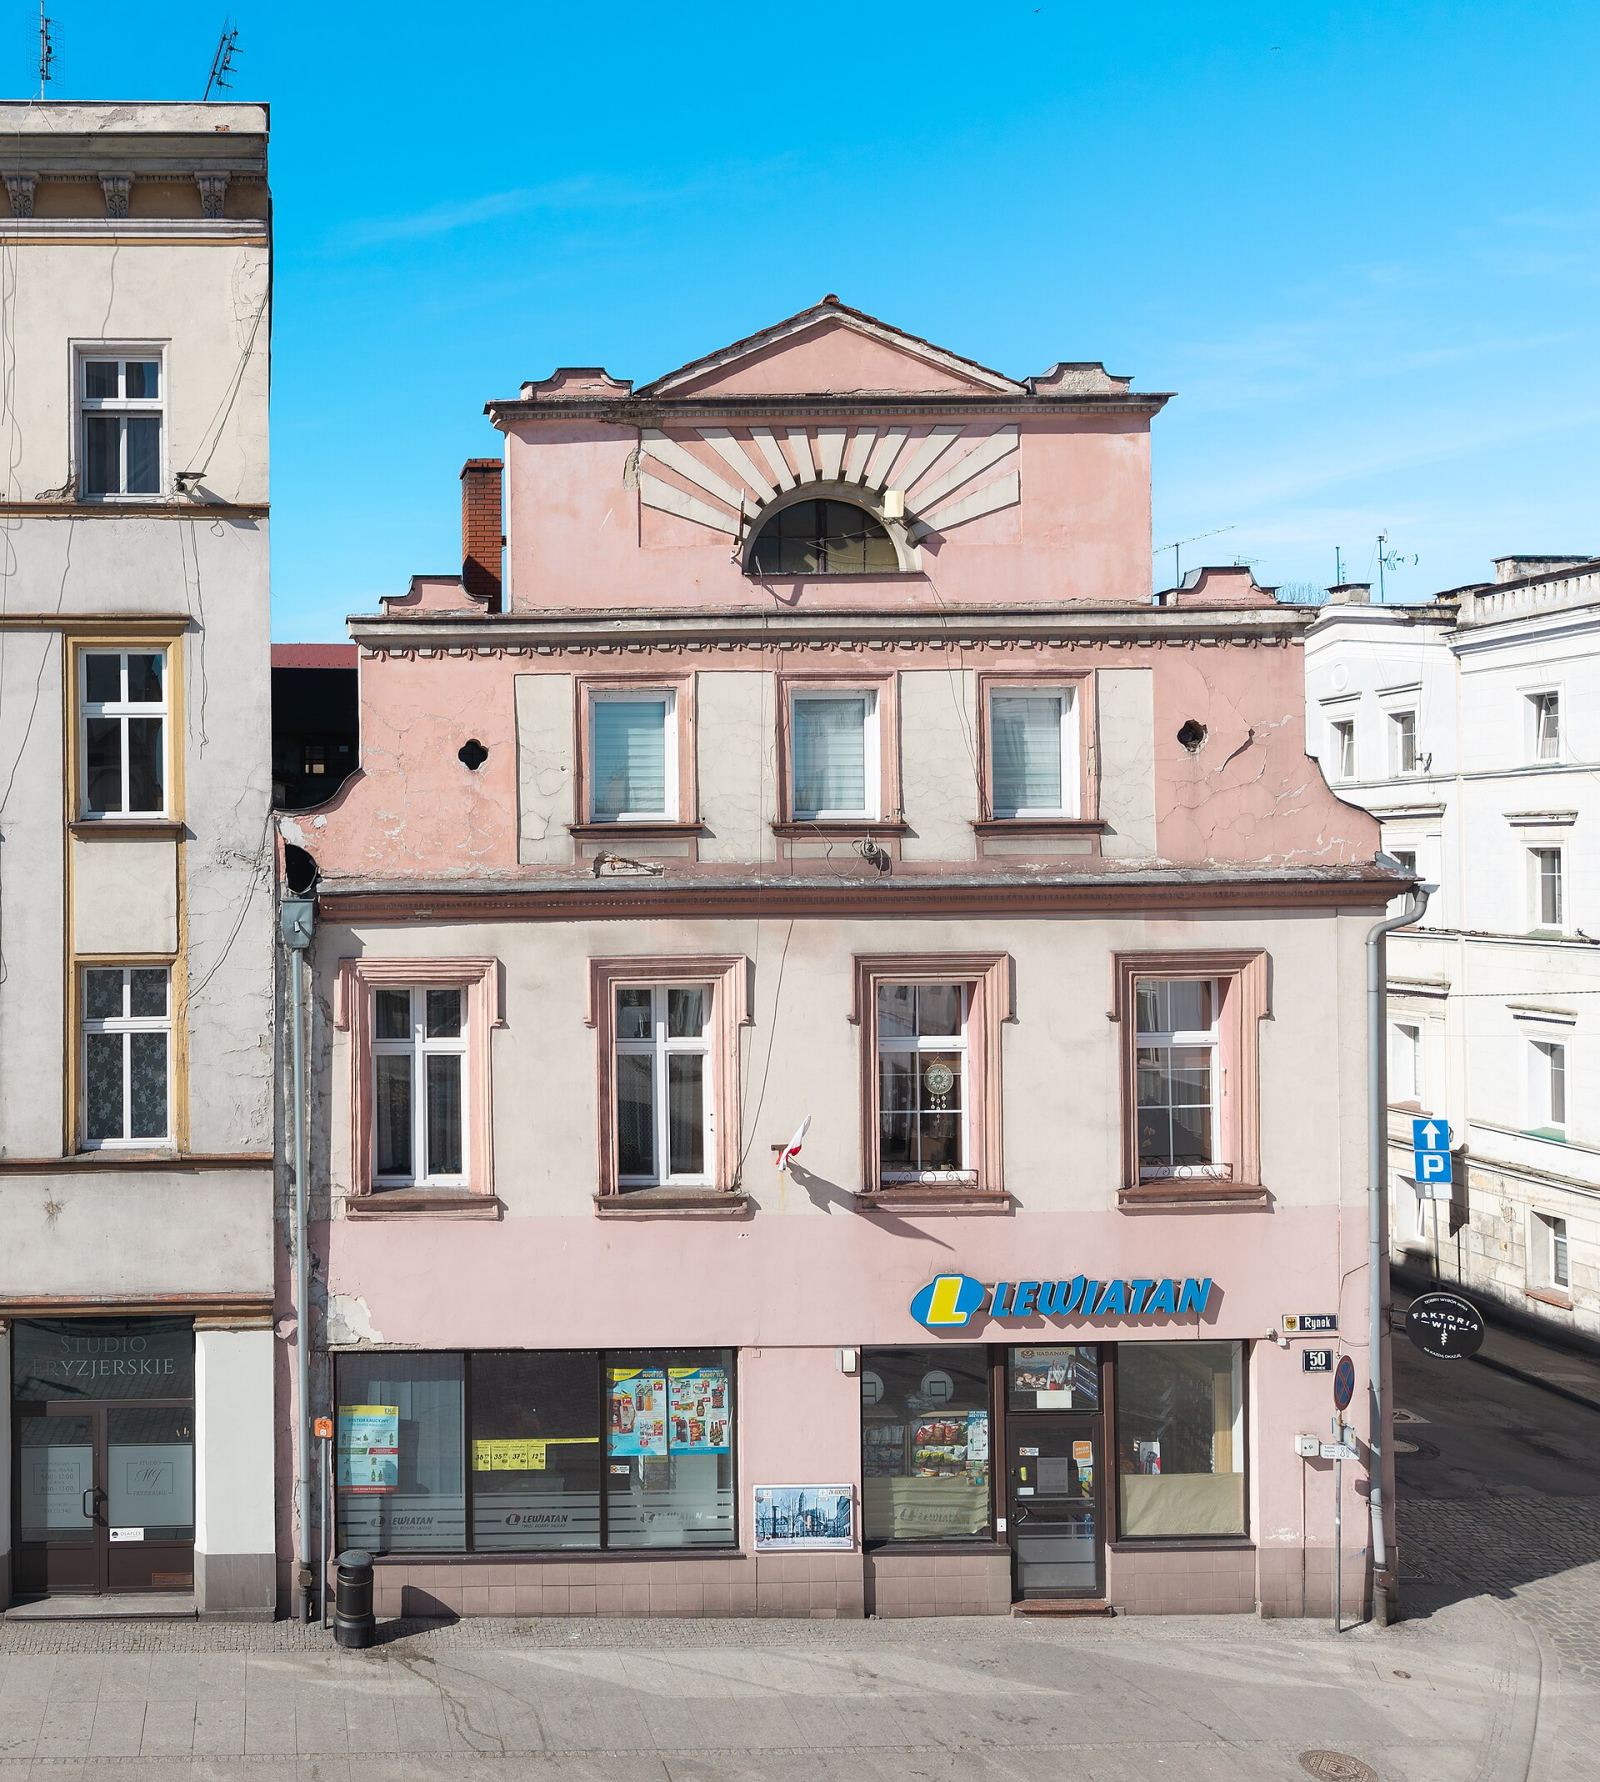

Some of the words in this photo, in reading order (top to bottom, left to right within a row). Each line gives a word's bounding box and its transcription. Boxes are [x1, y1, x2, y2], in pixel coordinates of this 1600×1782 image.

[1423, 1155, 1444, 1179] P
[990, 1274, 1213, 1317] LEWIATAN
[1304, 1316, 1331, 1330] Rynek
[1412, 1312, 1478, 1331] FAKTORIA
[1431, 1321, 1457, 1331] WIN
[60, 1335, 147, 1353] STUDIO
[1309, 1351, 1326, 1367] 50
[33, 1358, 175, 1379] FRYZJERSKIE
[522, 1514, 569, 1524] LEWIATAN
